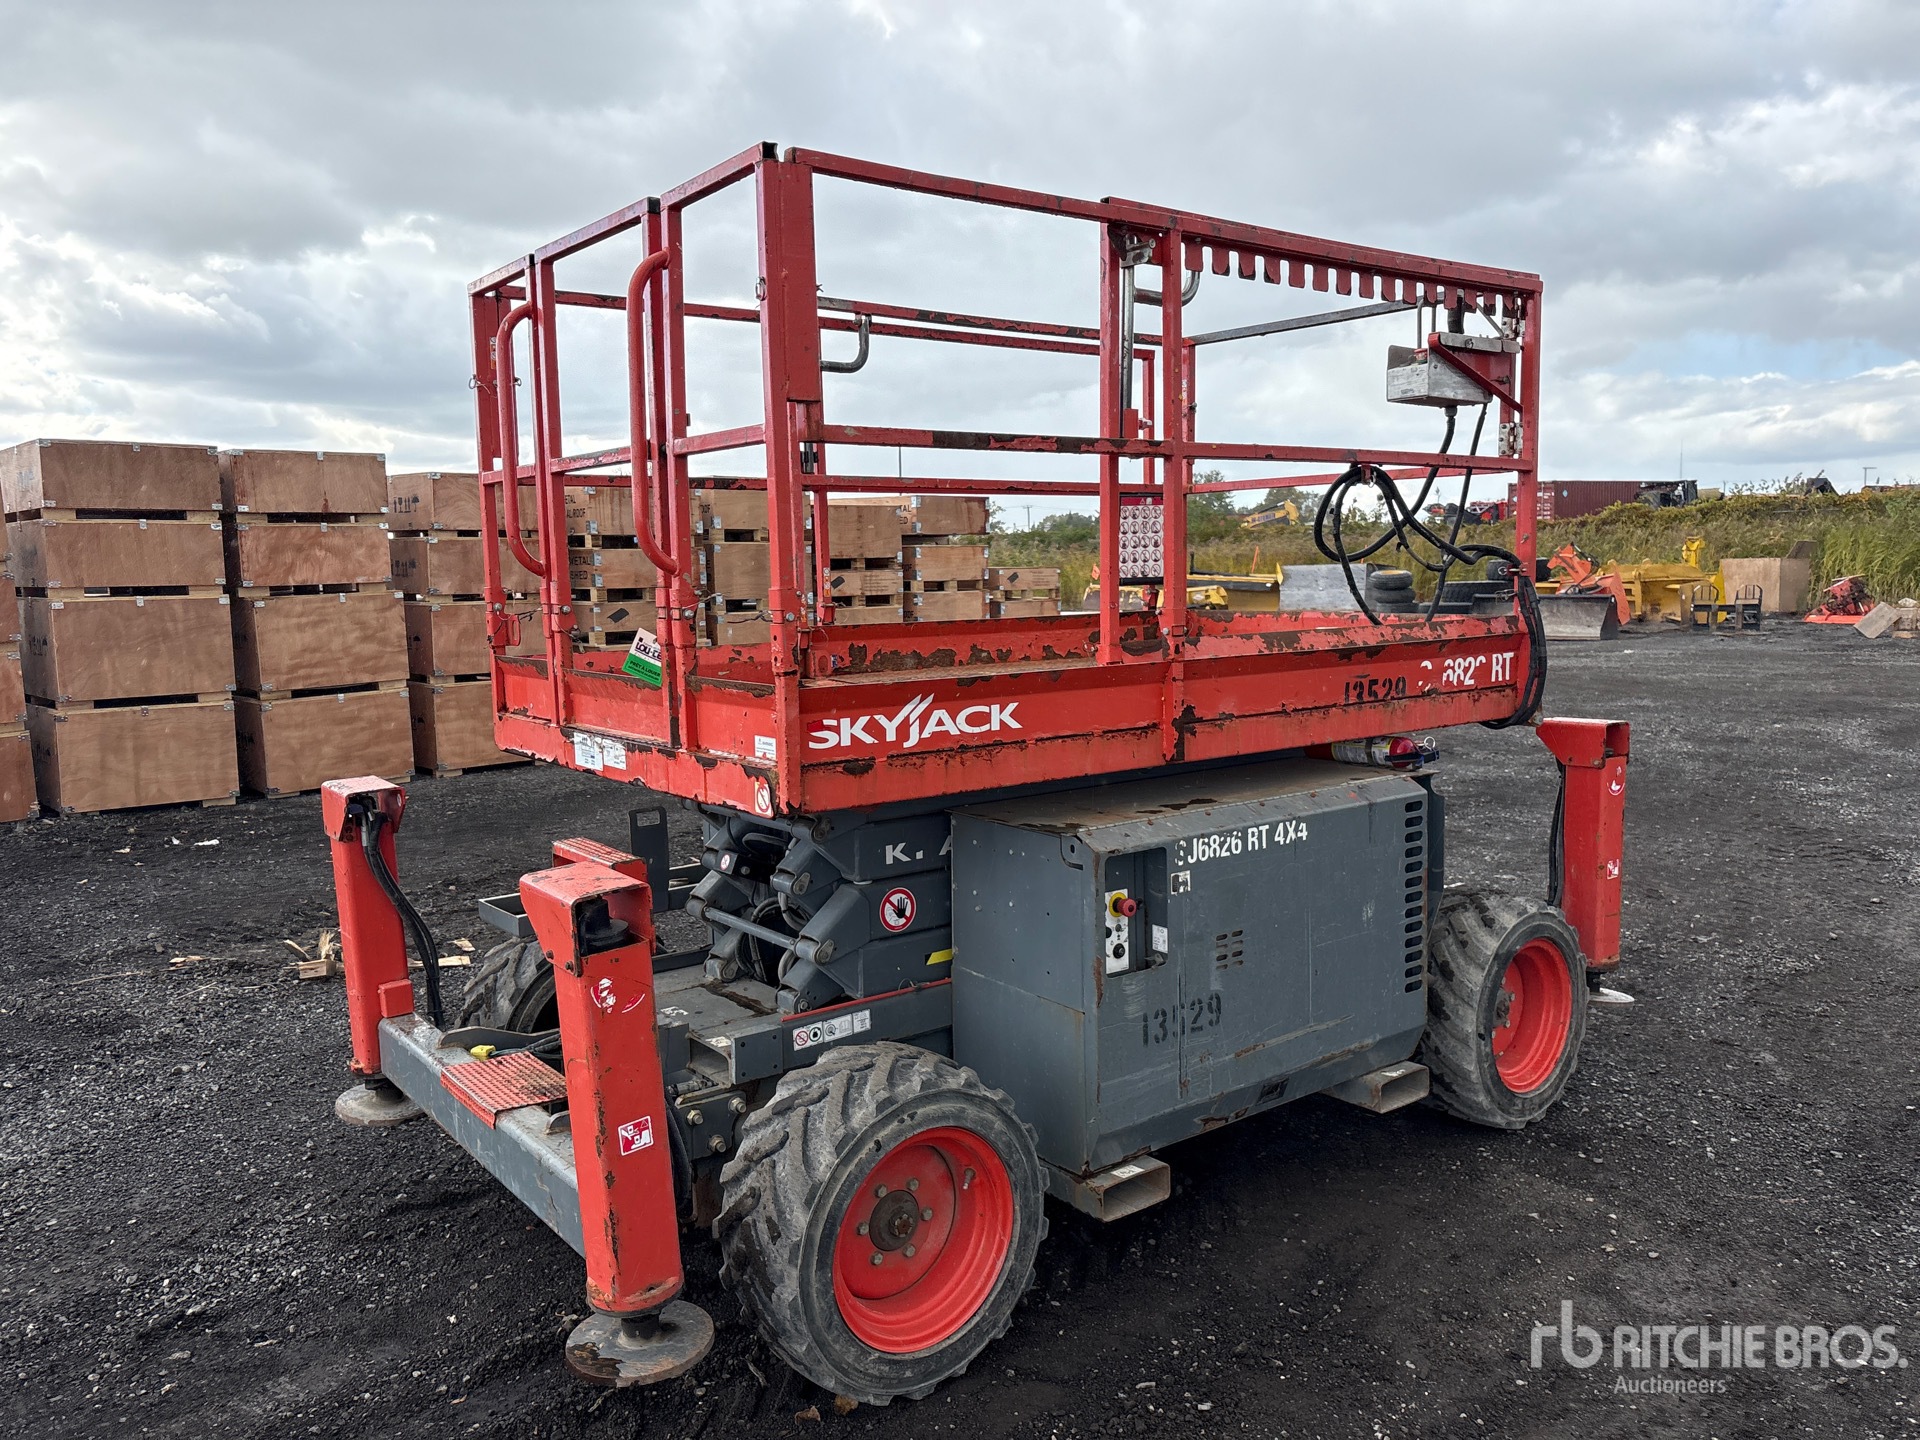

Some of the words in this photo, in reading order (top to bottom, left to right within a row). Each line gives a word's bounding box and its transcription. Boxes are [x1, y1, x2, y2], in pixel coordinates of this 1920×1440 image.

[1491, 652, 1515, 682] RT
[808, 693, 1023, 749] SKYJACK
[1247, 824, 1270, 851] RT
[1274, 820, 1308, 846] 4X4
